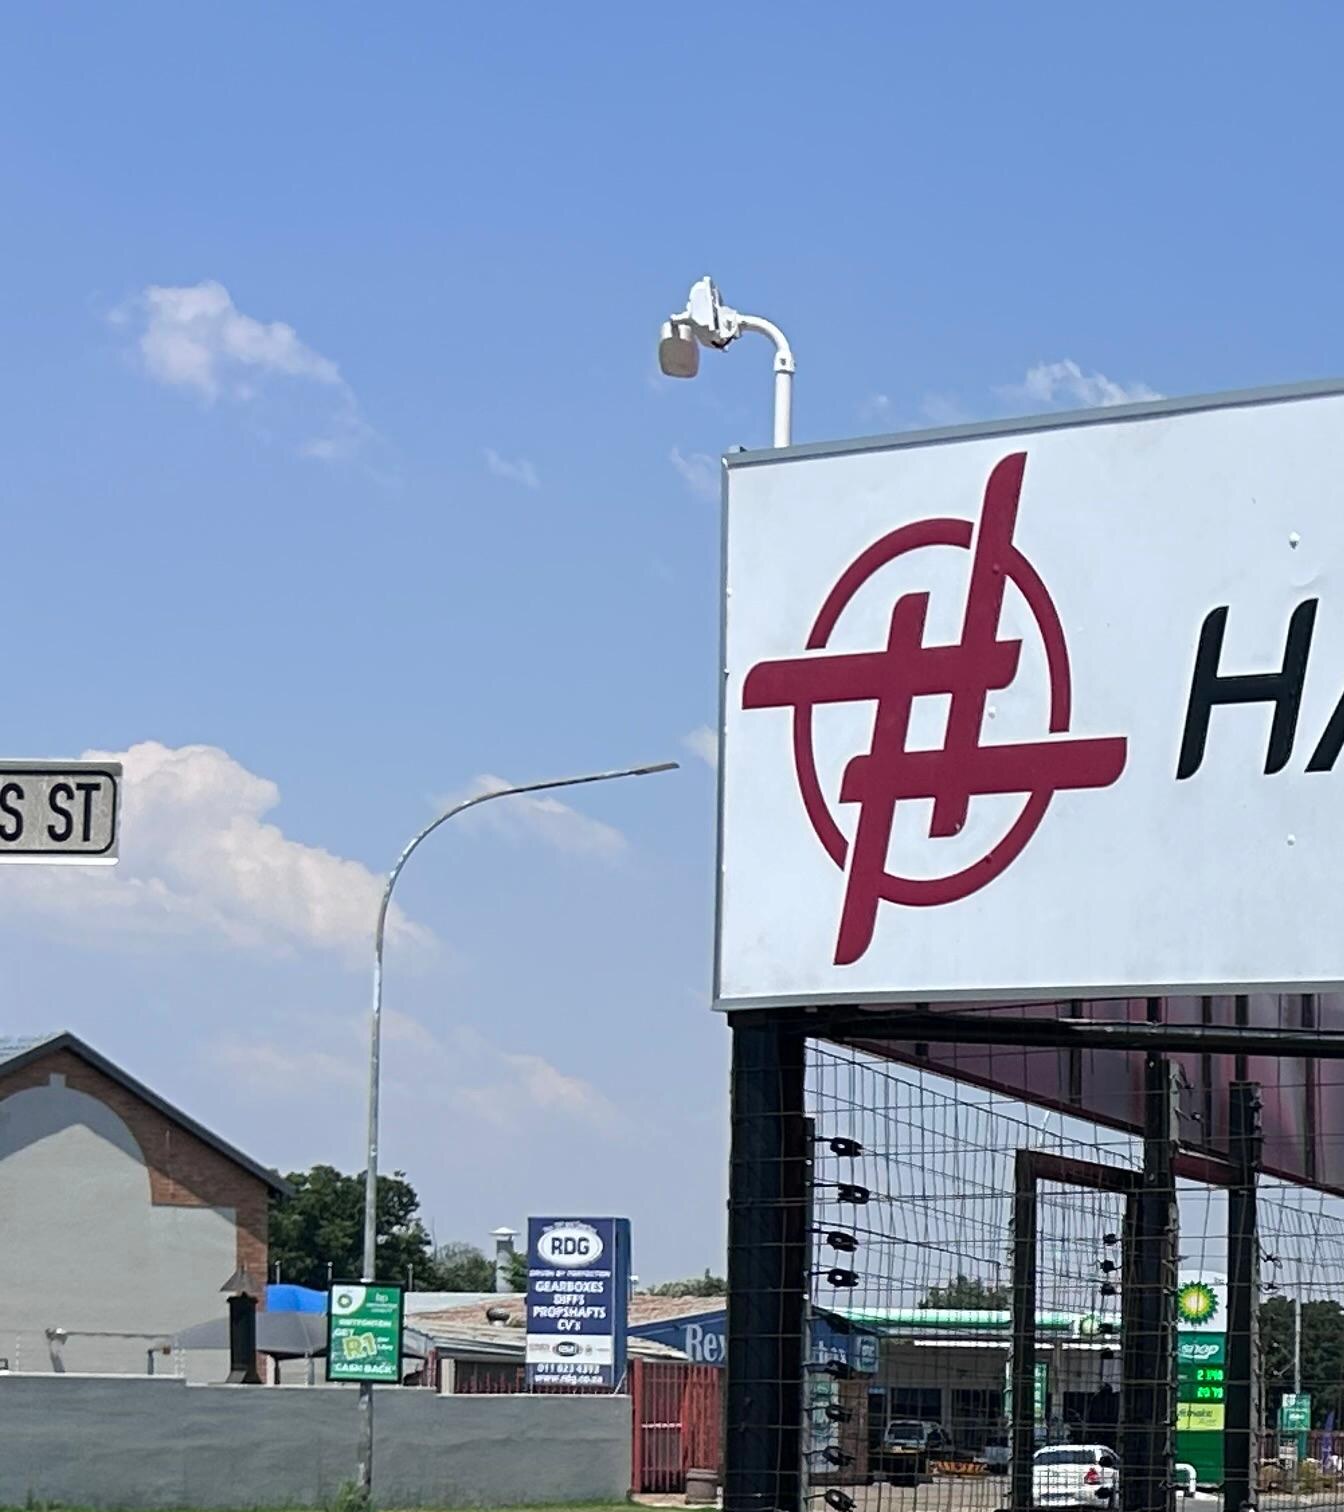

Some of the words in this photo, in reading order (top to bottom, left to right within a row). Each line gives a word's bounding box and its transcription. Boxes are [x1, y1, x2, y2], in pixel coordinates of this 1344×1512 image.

[47, 782, 101, 842] ST
[551, 1237, 590, 1255] RDG
[535, 1280, 604, 1293] GEARBOXES
[533, 1305, 607, 1318] PROPSHAFTS
[342, 1332, 378, 1360] R1
